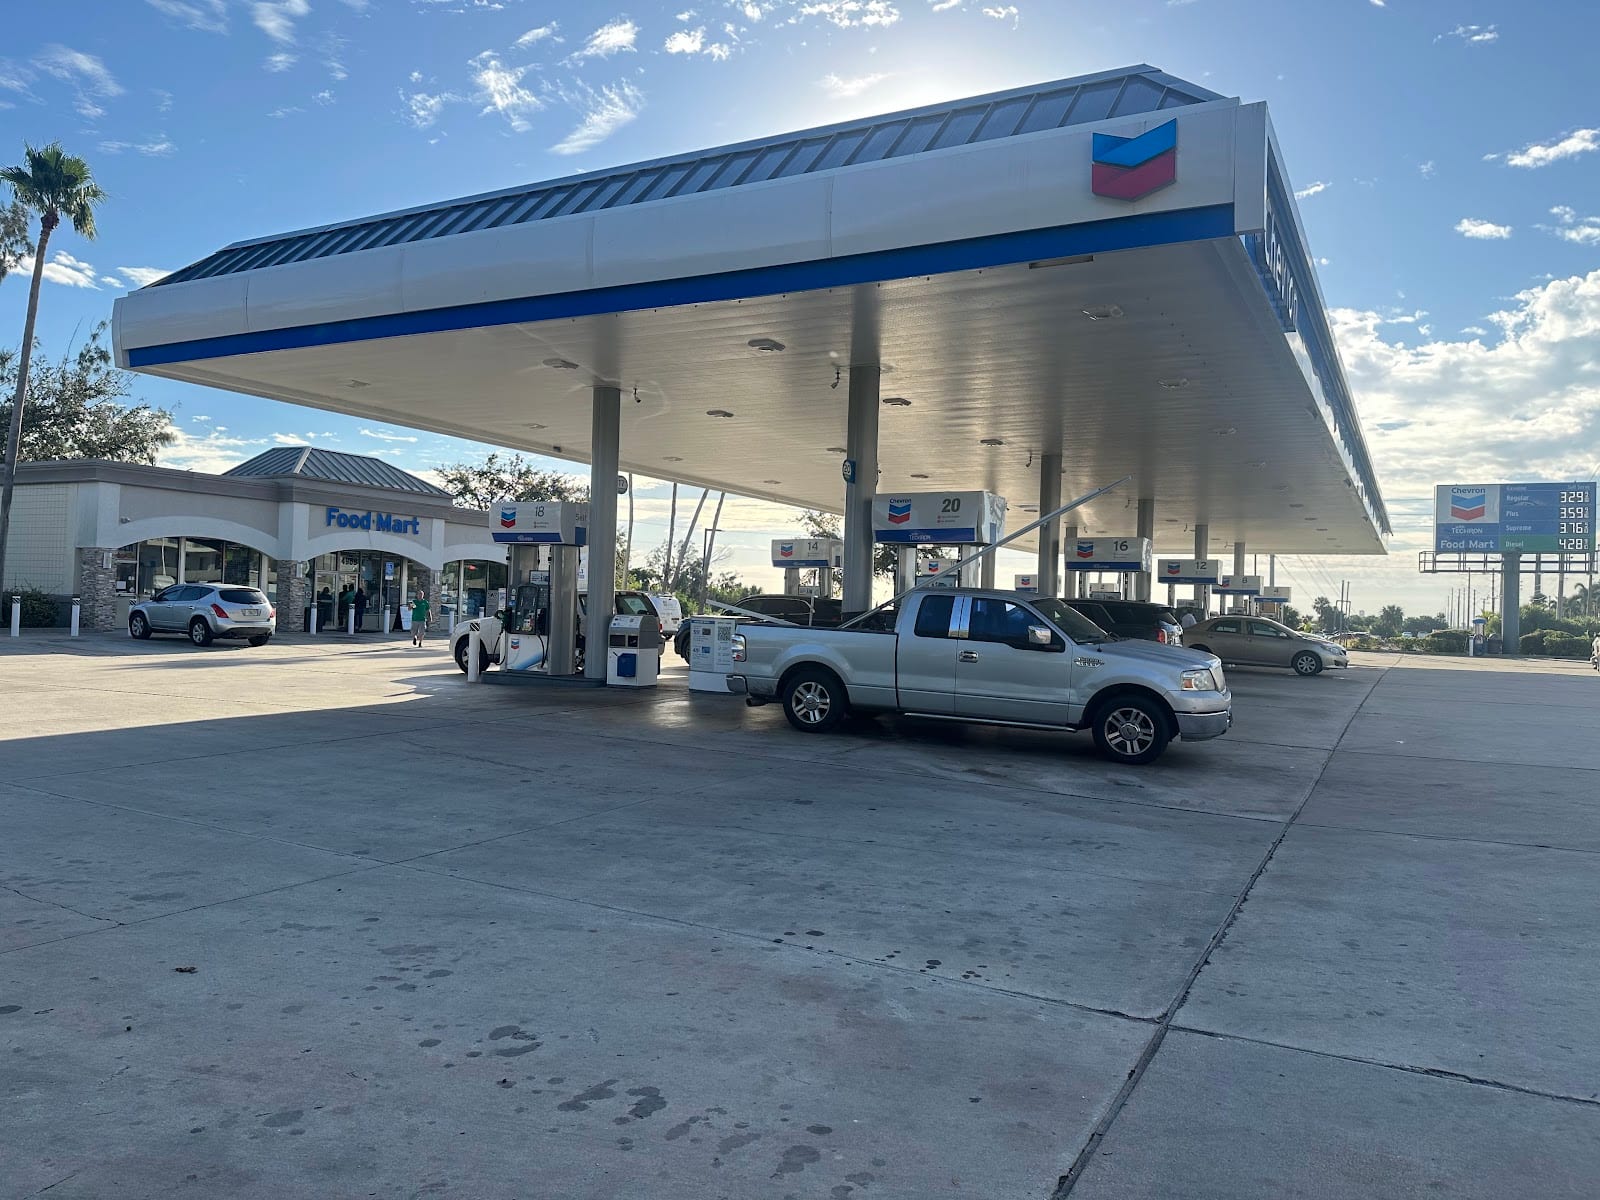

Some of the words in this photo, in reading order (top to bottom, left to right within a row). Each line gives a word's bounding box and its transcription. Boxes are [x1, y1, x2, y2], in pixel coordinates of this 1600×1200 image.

[941, 498, 961, 513] 20
[535, 505, 545, 517] 18
[326, 506, 371, 531] Food
[376, 512, 420, 535] Mart
[807, 542, 818, 551] 14
[1114, 540, 1129, 551] 16
[1440, 540, 1465, 549] Food
[1469, 540, 1494, 549] Mart
[1505, 540, 1524, 548] Diesel
[1195, 561, 1207, 570] 12
